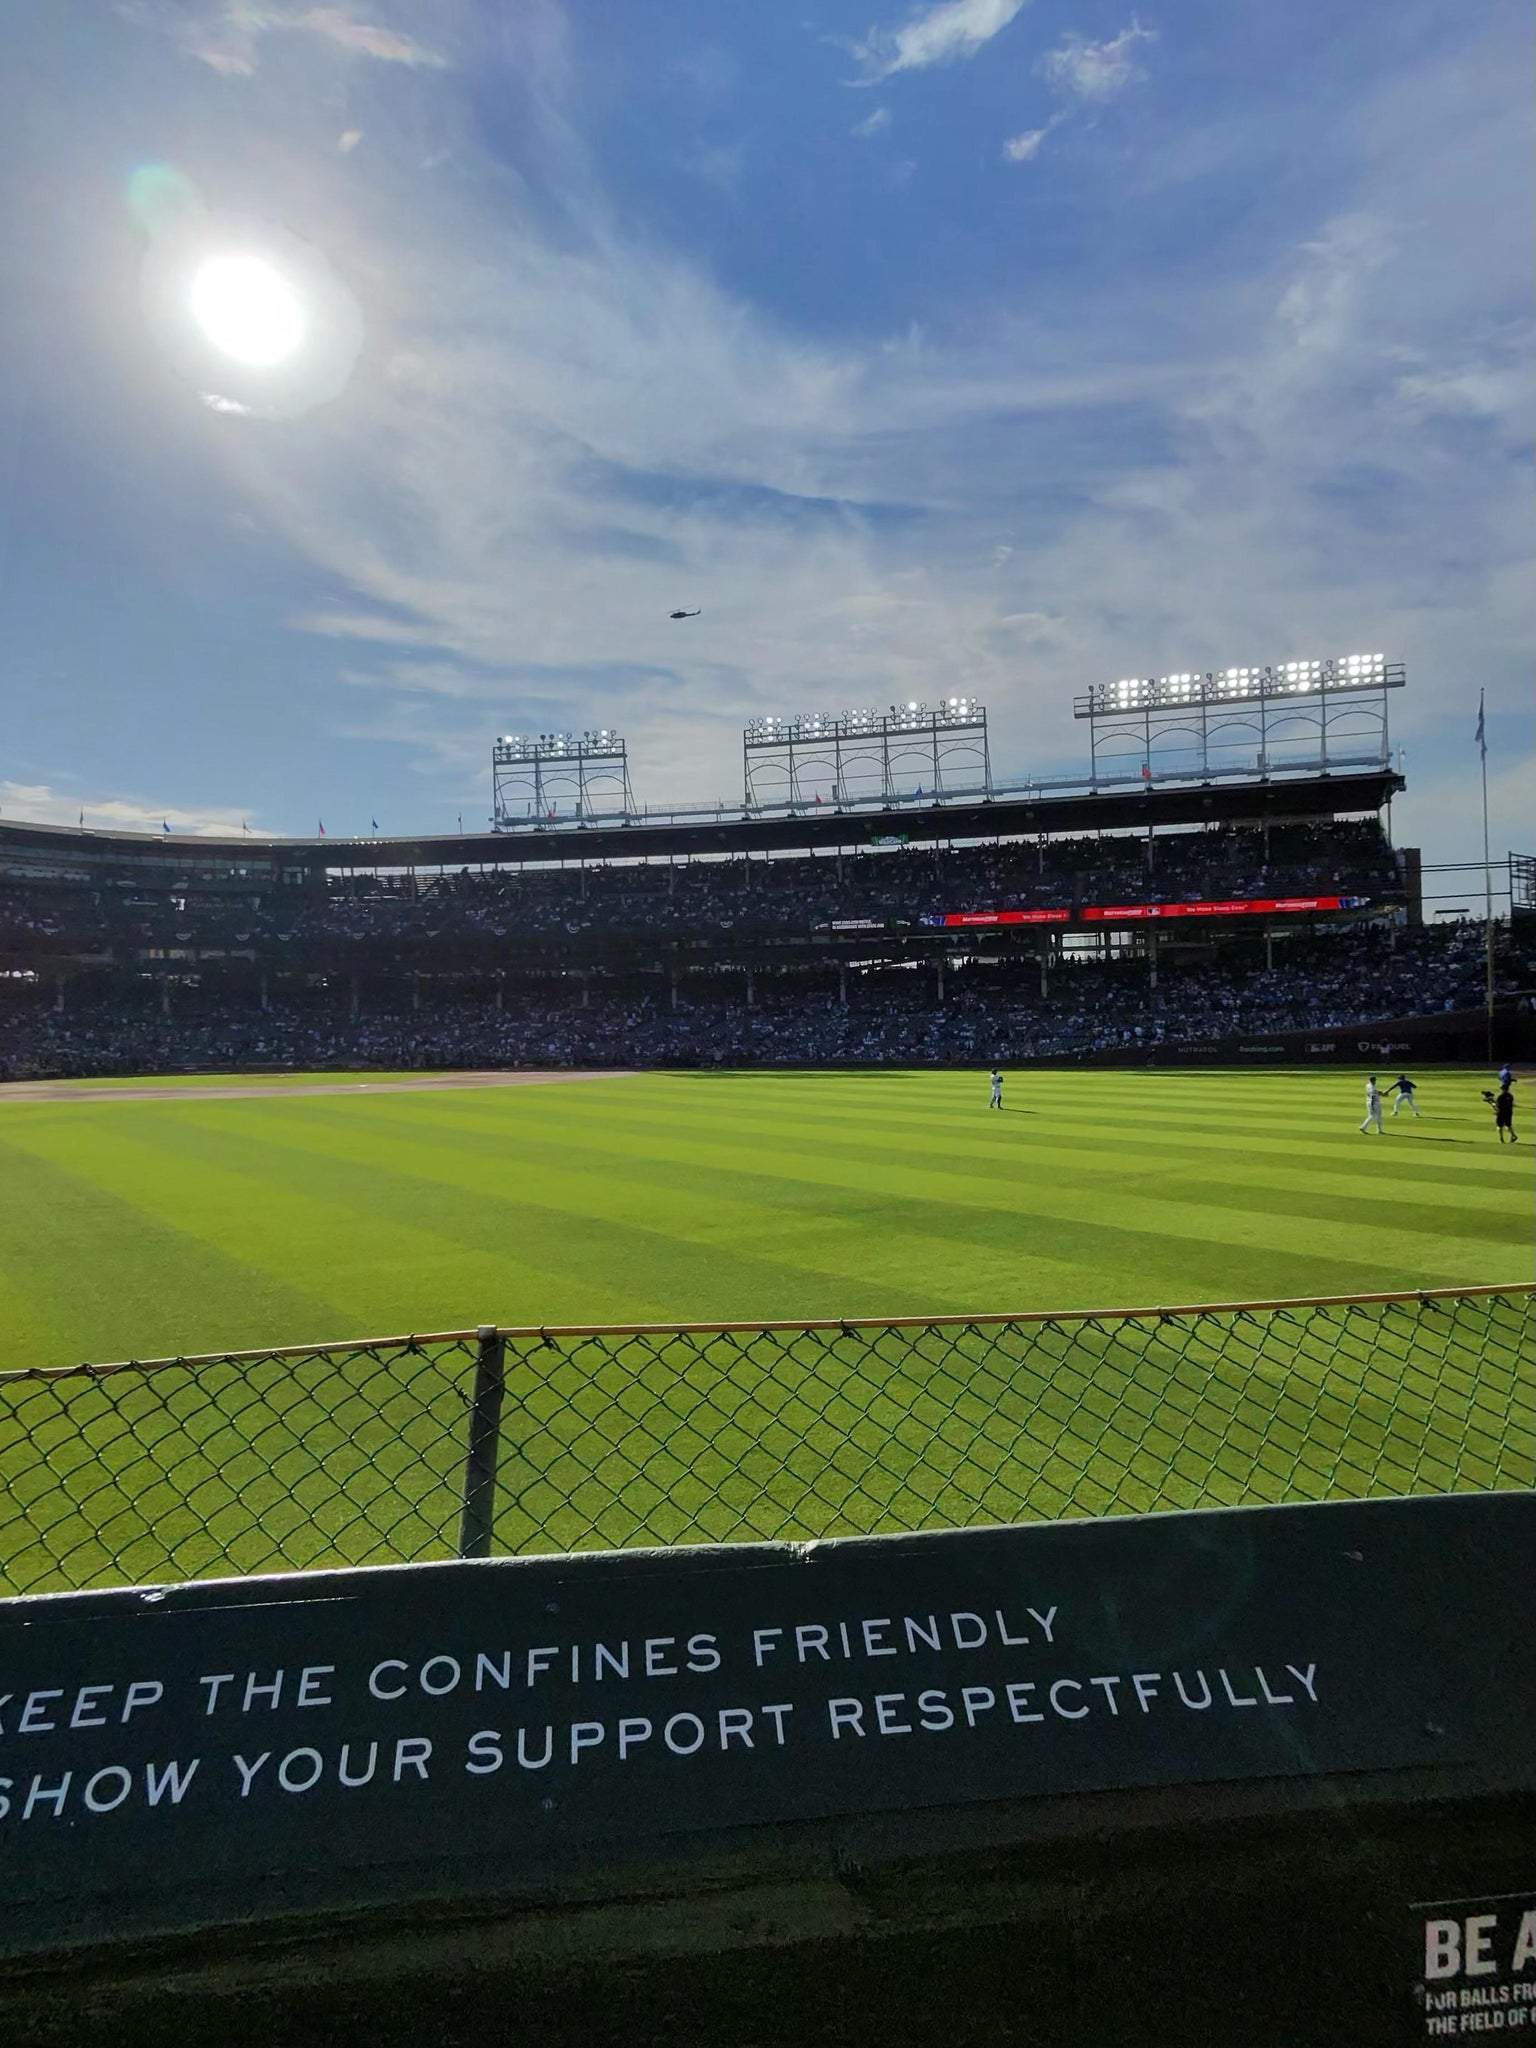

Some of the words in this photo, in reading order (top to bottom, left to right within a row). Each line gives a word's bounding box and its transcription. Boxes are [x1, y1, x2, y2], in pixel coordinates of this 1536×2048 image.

[200, 1666, 334, 1715] THE
[369, 1635, 721, 1700] CONFINES
[753, 1606, 1058, 1667] FRIENDLY
[234, 1737, 432, 1797] YOUR
[465, 1704, 793, 1775] SUPPORT
[829, 1664, 1318, 1739] RESPECTFULLY
[1425, 1914, 1498, 1980] BE
[1426, 2015, 1458, 2035] THE
[1460, 2010, 1504, 2032] FIELD
[1508, 2007, 1528, 2026] OF
[1460, 1986, 1510, 2007] BALLS
